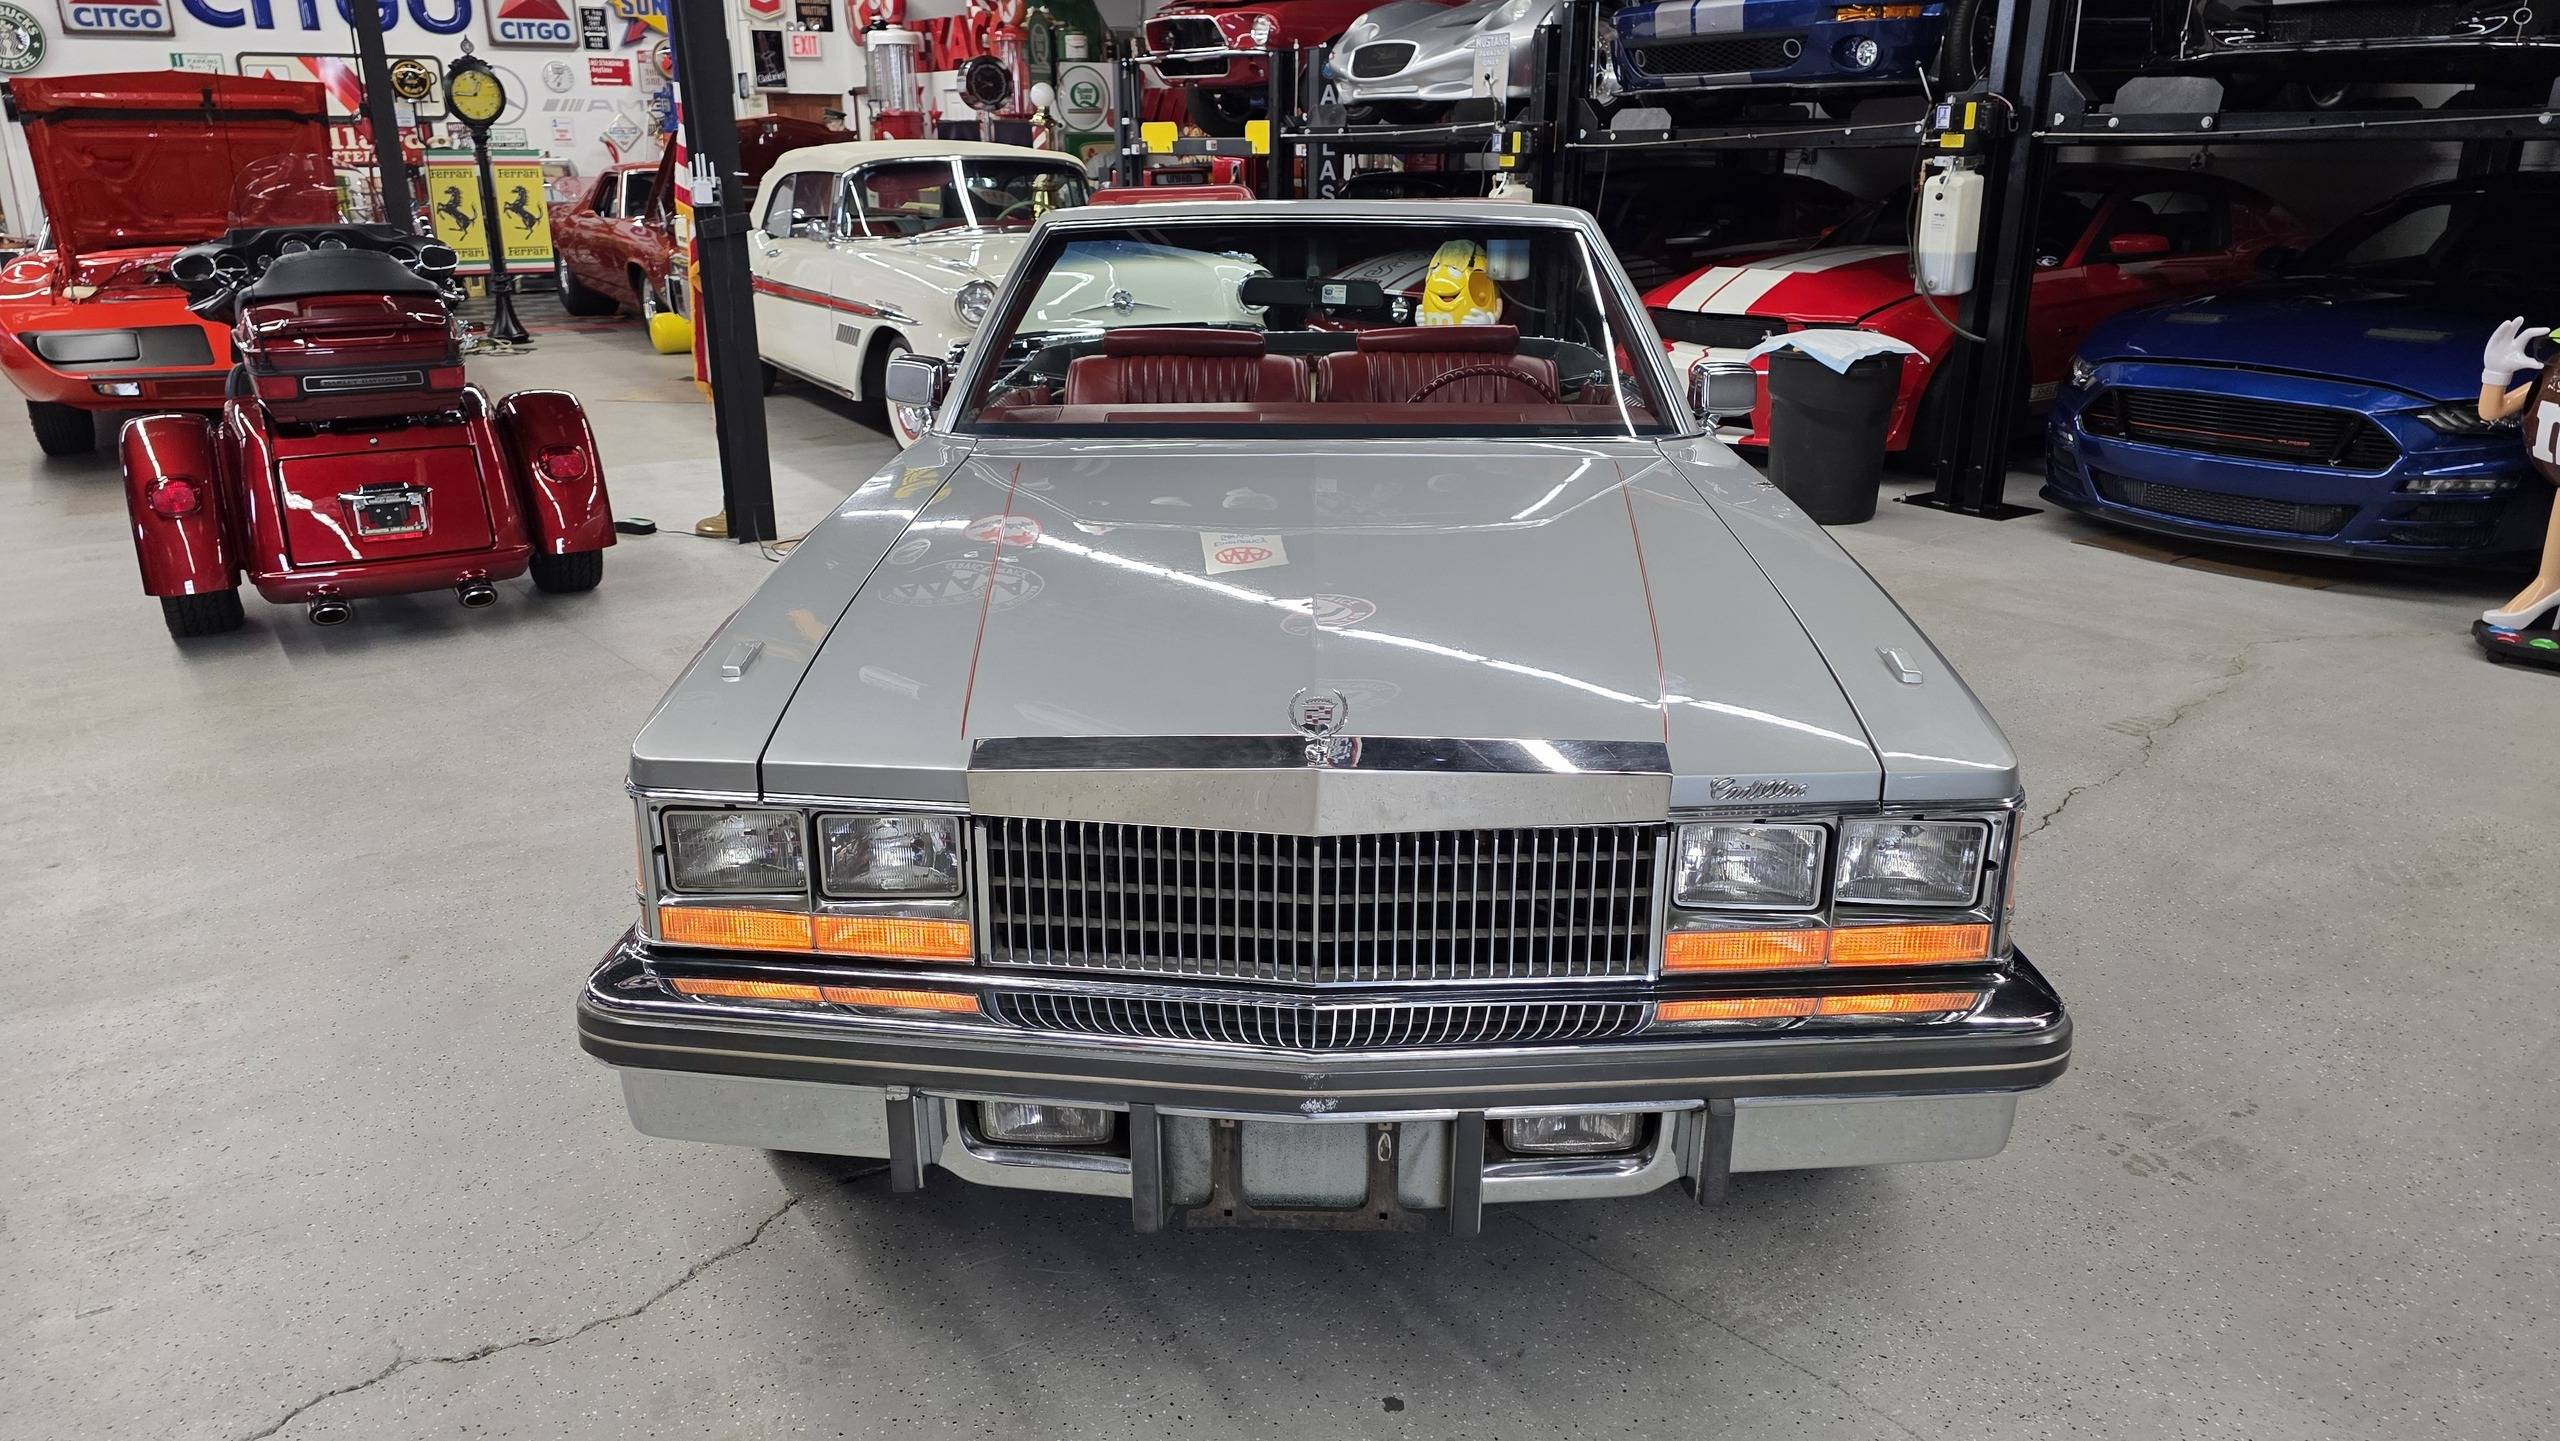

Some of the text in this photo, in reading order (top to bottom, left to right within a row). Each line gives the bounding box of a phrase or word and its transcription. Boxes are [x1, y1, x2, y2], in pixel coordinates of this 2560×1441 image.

[73, 7, 162, 28] CITGO
[500, 22, 571, 41] CITGO
[792, 35, 817, 55] EXIT
[0, 51, 36, 69] FFEE
[430, 168, 473, 178] Ferrari
[498, 168, 540, 178] Ferrari
[458, 246, 485, 258] rrari
[508, 246, 550, 257] Ferrari
[322, 375, 406, 386] HARLEY-DAVIDSON
[1709, 776, 1809, 801] Cadillac
